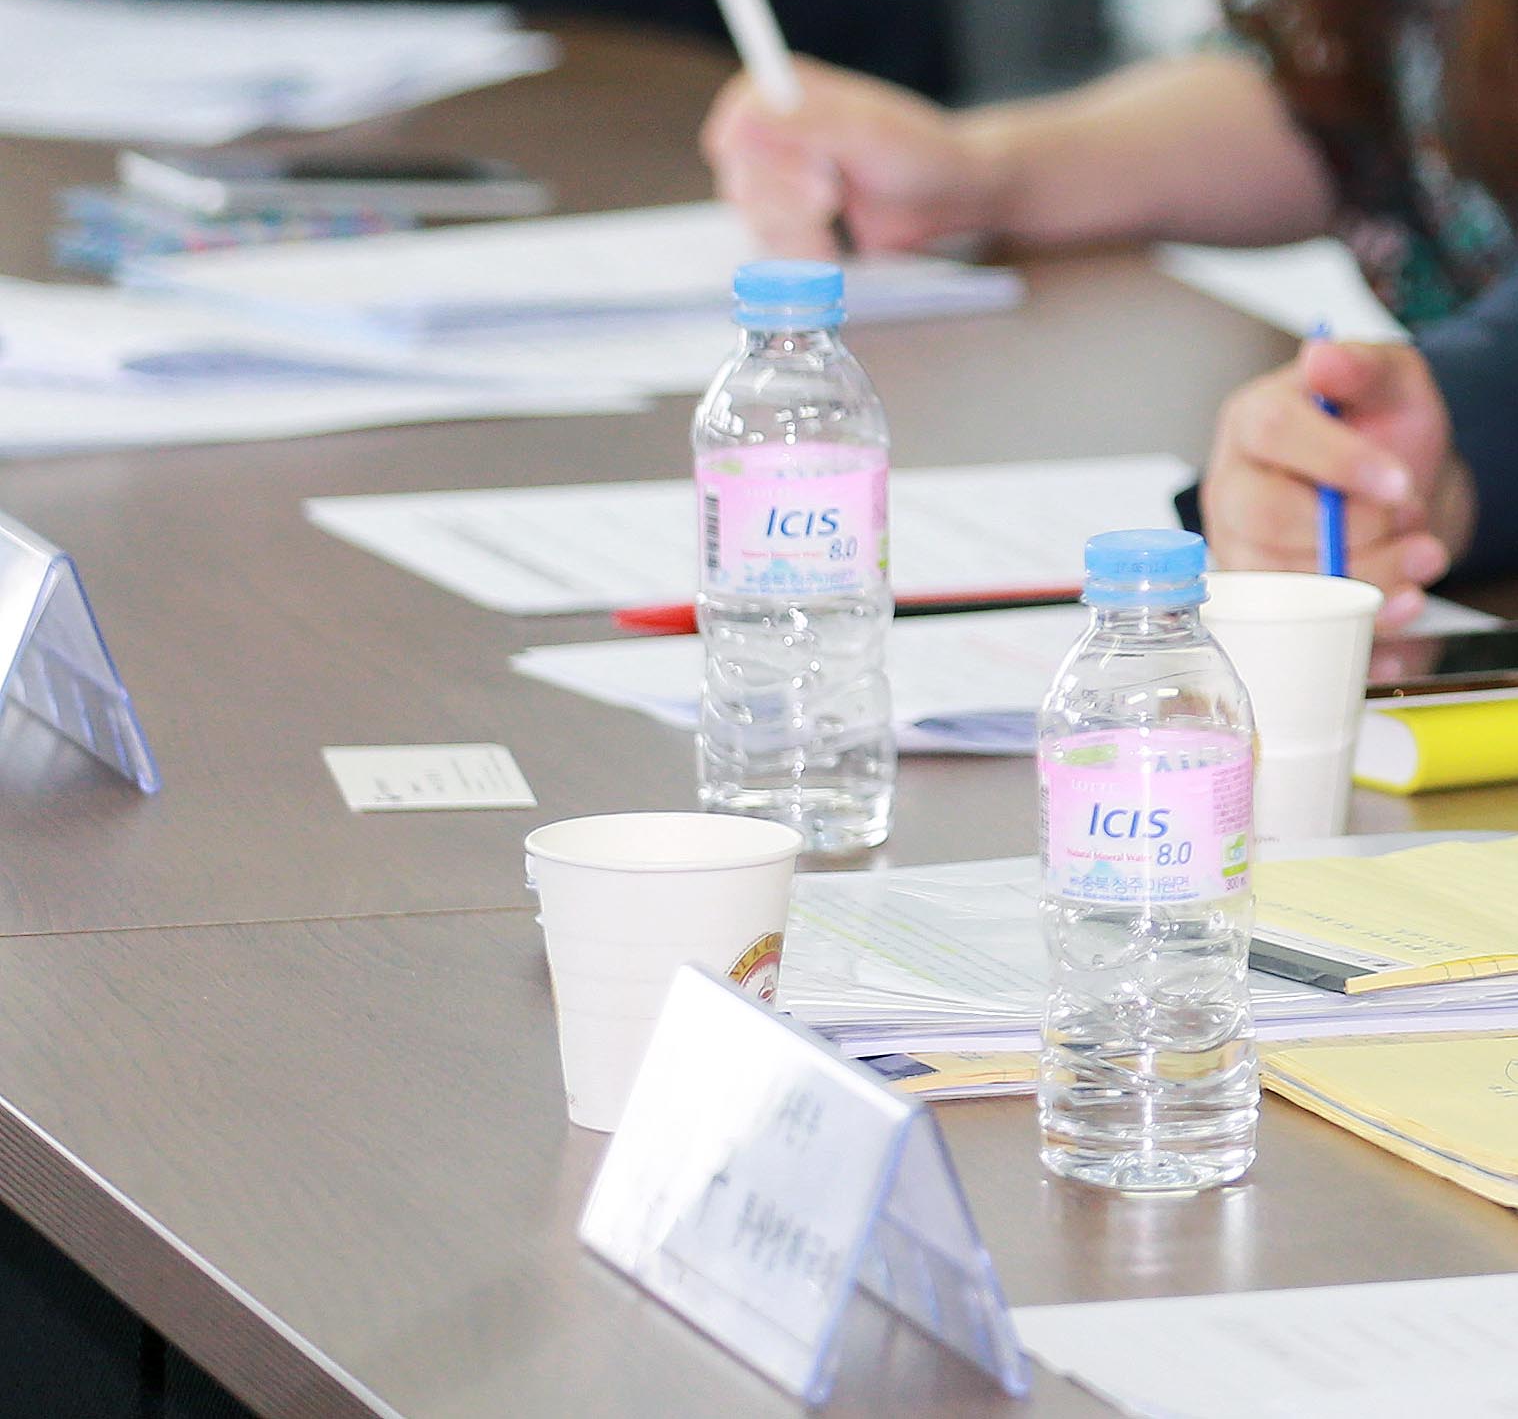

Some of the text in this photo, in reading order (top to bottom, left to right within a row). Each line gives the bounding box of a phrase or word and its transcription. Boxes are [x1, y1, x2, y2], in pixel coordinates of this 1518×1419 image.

[766, 506, 841, 539] ICIS
[829, 536, 859, 562] 8.0
[1088, 802, 1172, 839] ICIS
[1156, 841, 1193, 867] 8.0
